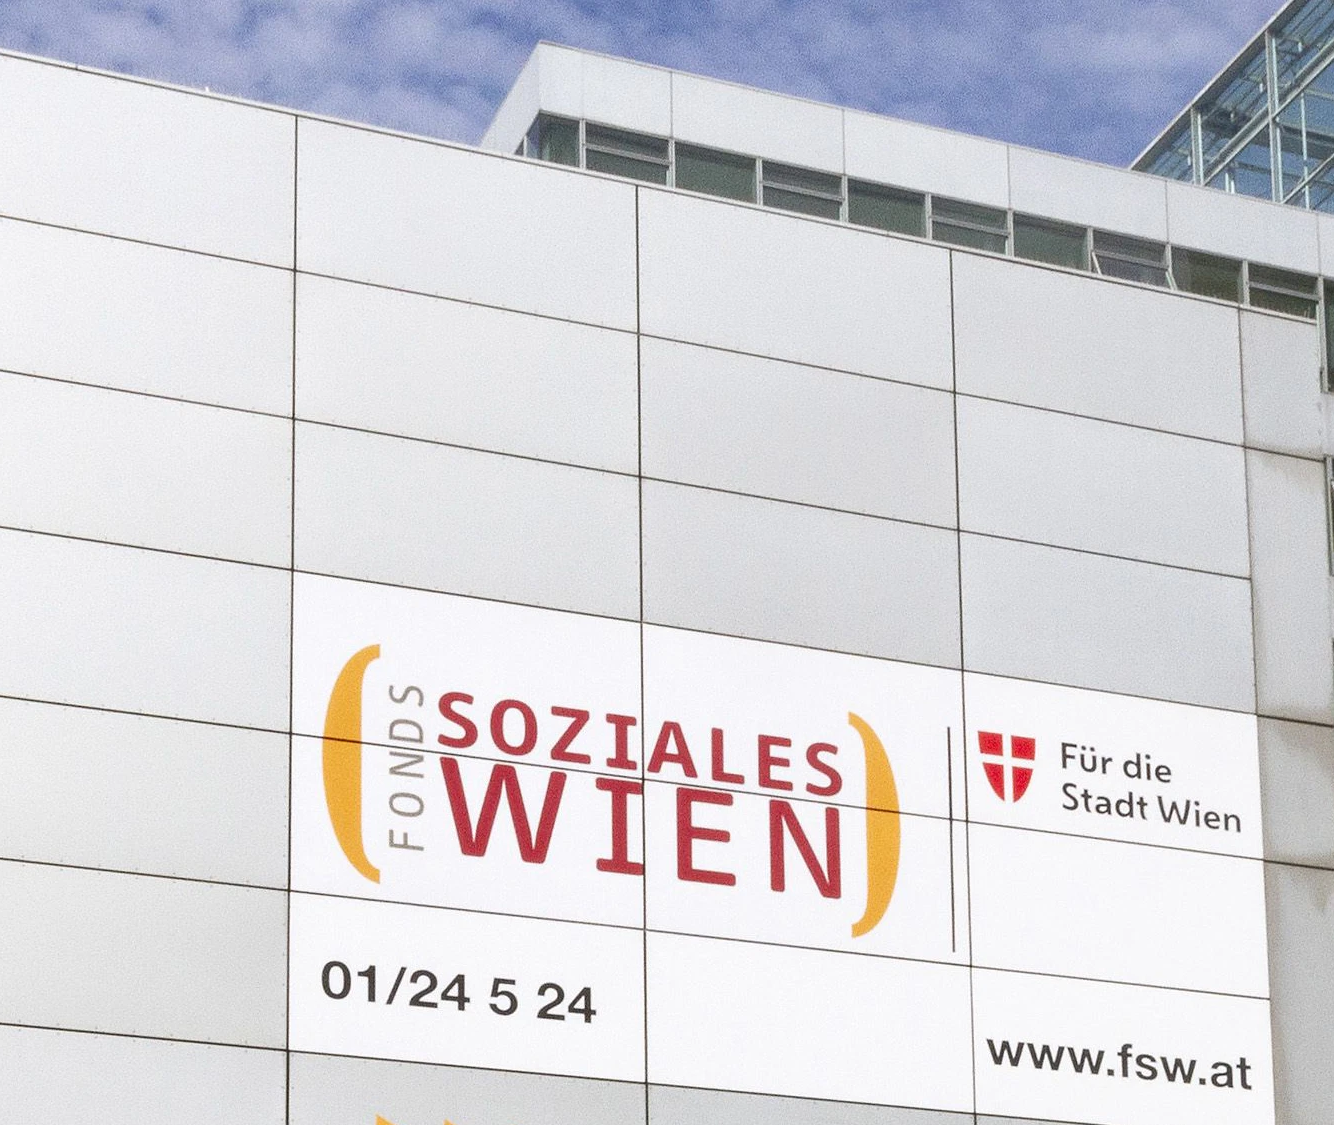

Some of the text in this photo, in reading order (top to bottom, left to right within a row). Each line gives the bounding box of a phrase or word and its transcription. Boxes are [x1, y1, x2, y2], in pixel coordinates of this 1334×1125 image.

[388, 683, 426, 853] FONDS
[438, 690, 844, 796] SOZIALES
[1060, 742, 1172, 784] Für die
[440, 755, 841, 901] WIEN
[1061, 783, 1243, 833] Stadt Wien
[321, 959, 597, 1024] 01/24 5 24
[986, 1037, 1253, 1091] www.fsw.at
